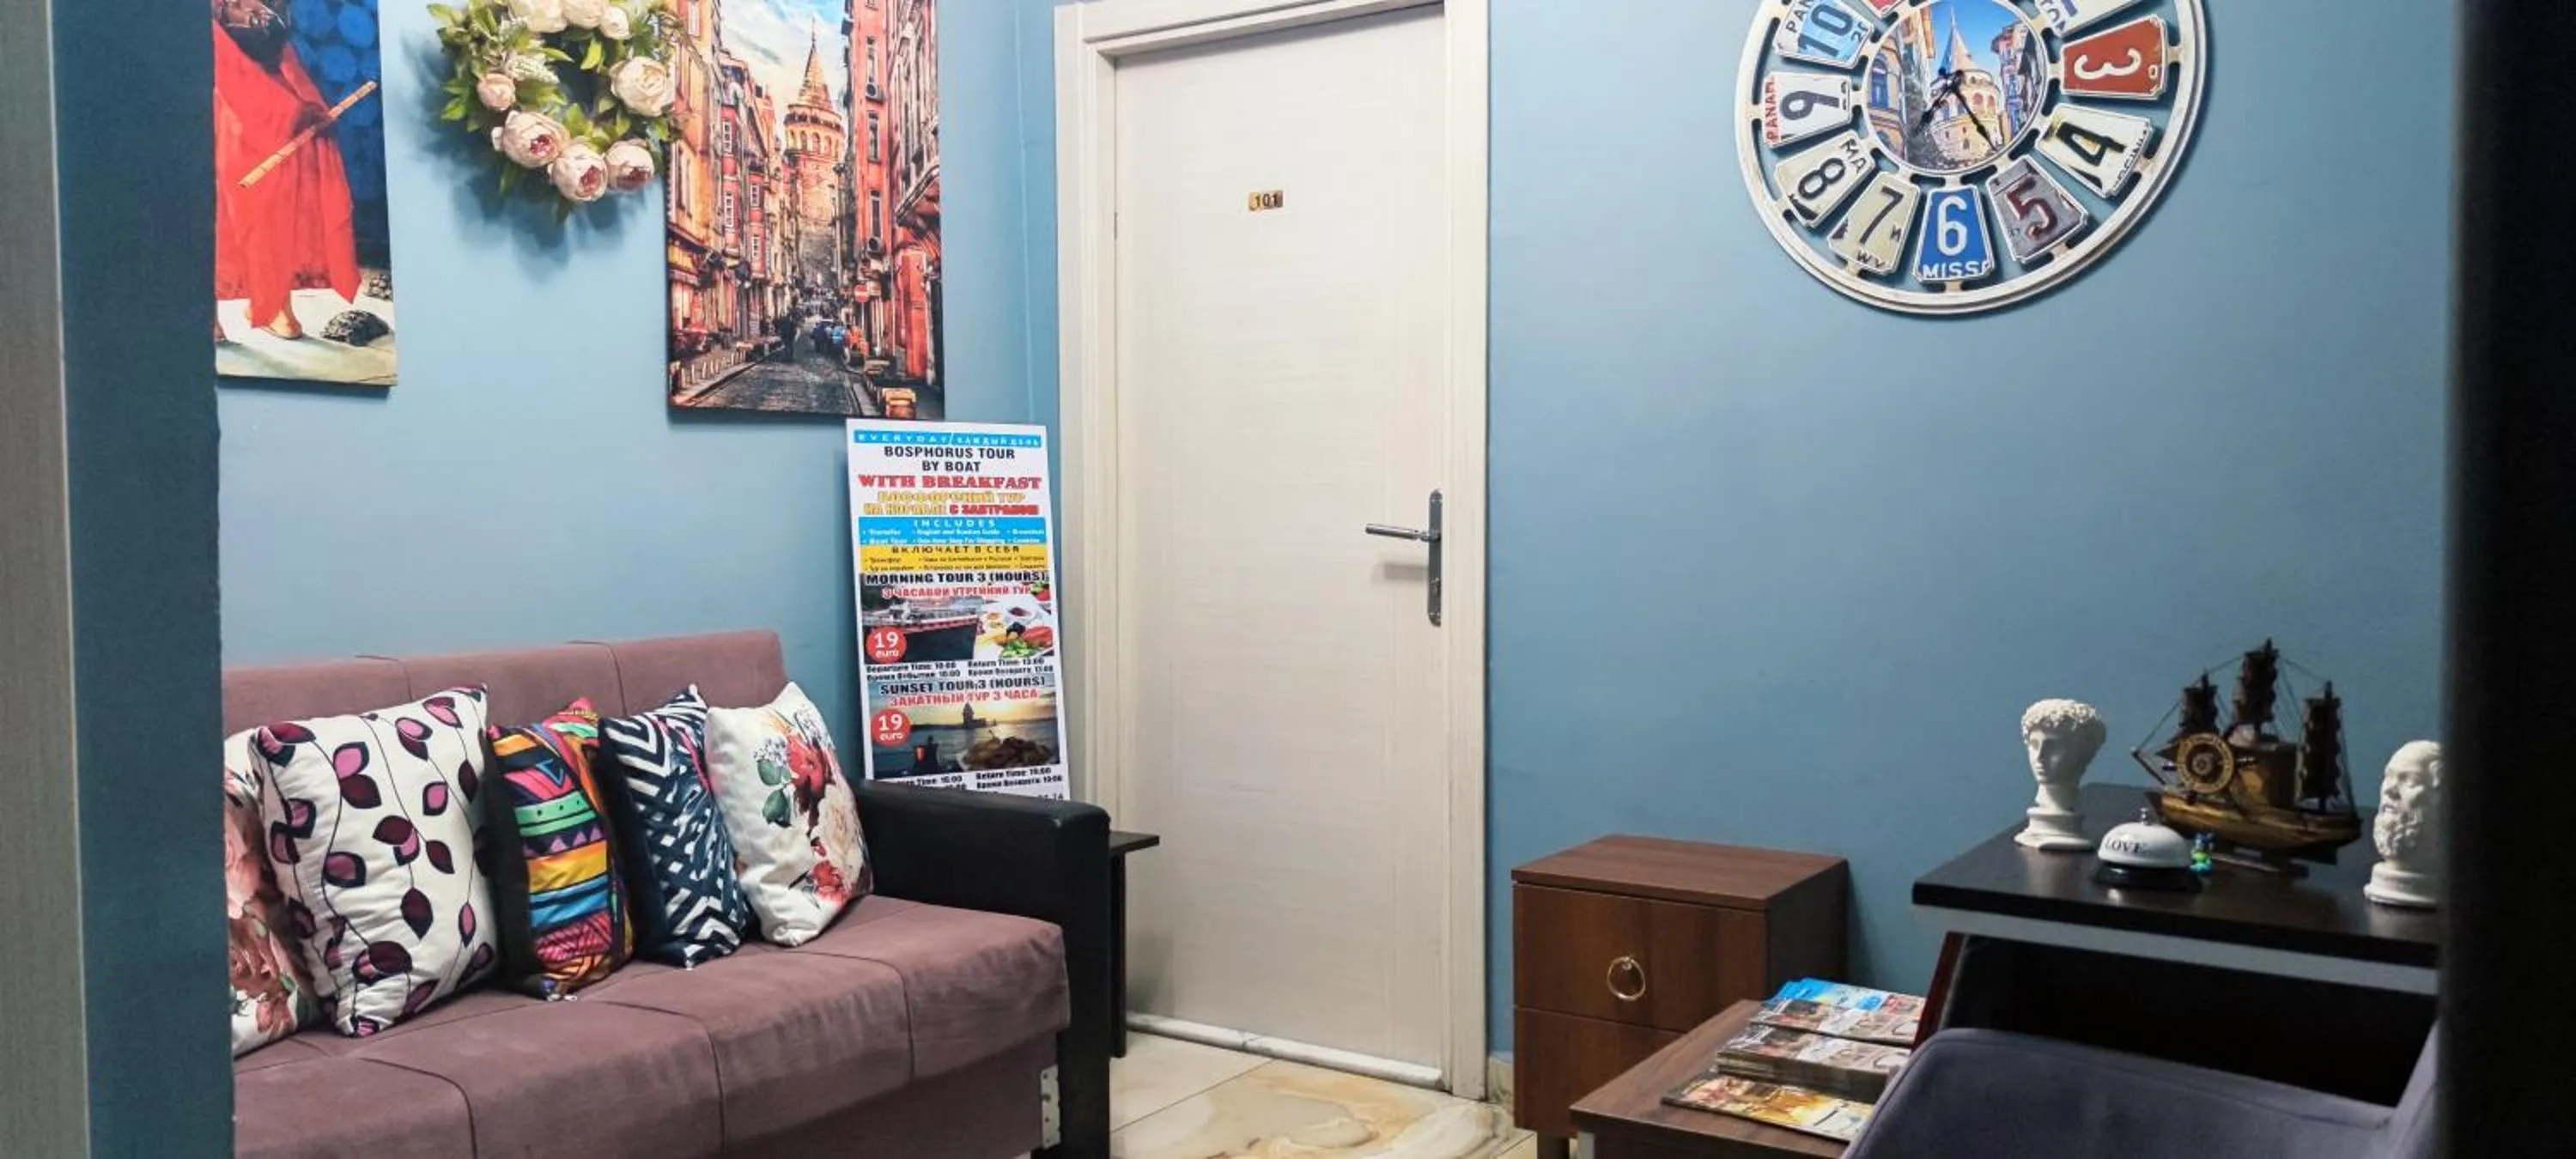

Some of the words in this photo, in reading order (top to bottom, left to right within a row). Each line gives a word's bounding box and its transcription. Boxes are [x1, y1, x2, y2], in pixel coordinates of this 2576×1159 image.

[1798, 3, 1852, 58] 10
[2075, 48, 2142, 79] 3
[1781, 90, 1839, 120] 9
[2056, 122, 2126, 166] 4
[1798, 158, 1845, 200] 8
[1860, 185, 1904, 244] 7
[2007, 176, 2057, 240] 5
[1937, 196, 1967, 256] 6
[884, 446, 973, 458] BOSPHORUS
[978, 448, 1015, 458] TOUR
[921, 460, 939, 470] BY
[945, 462, 981, 471] BOAT
[858, 475, 915, 488] WITH
[921, 475, 1042, 489] BREAKFAST
[866, 573, 933, 584] MORNING
[938, 573, 974, 583] TOUR
[977, 573, 986, 582] 3
[874, 632, 899, 648] 19
[880, 683, 933, 695] SUNSET
[878, 714, 902, 731] 19
[2105, 838, 2143, 853] LOVE
